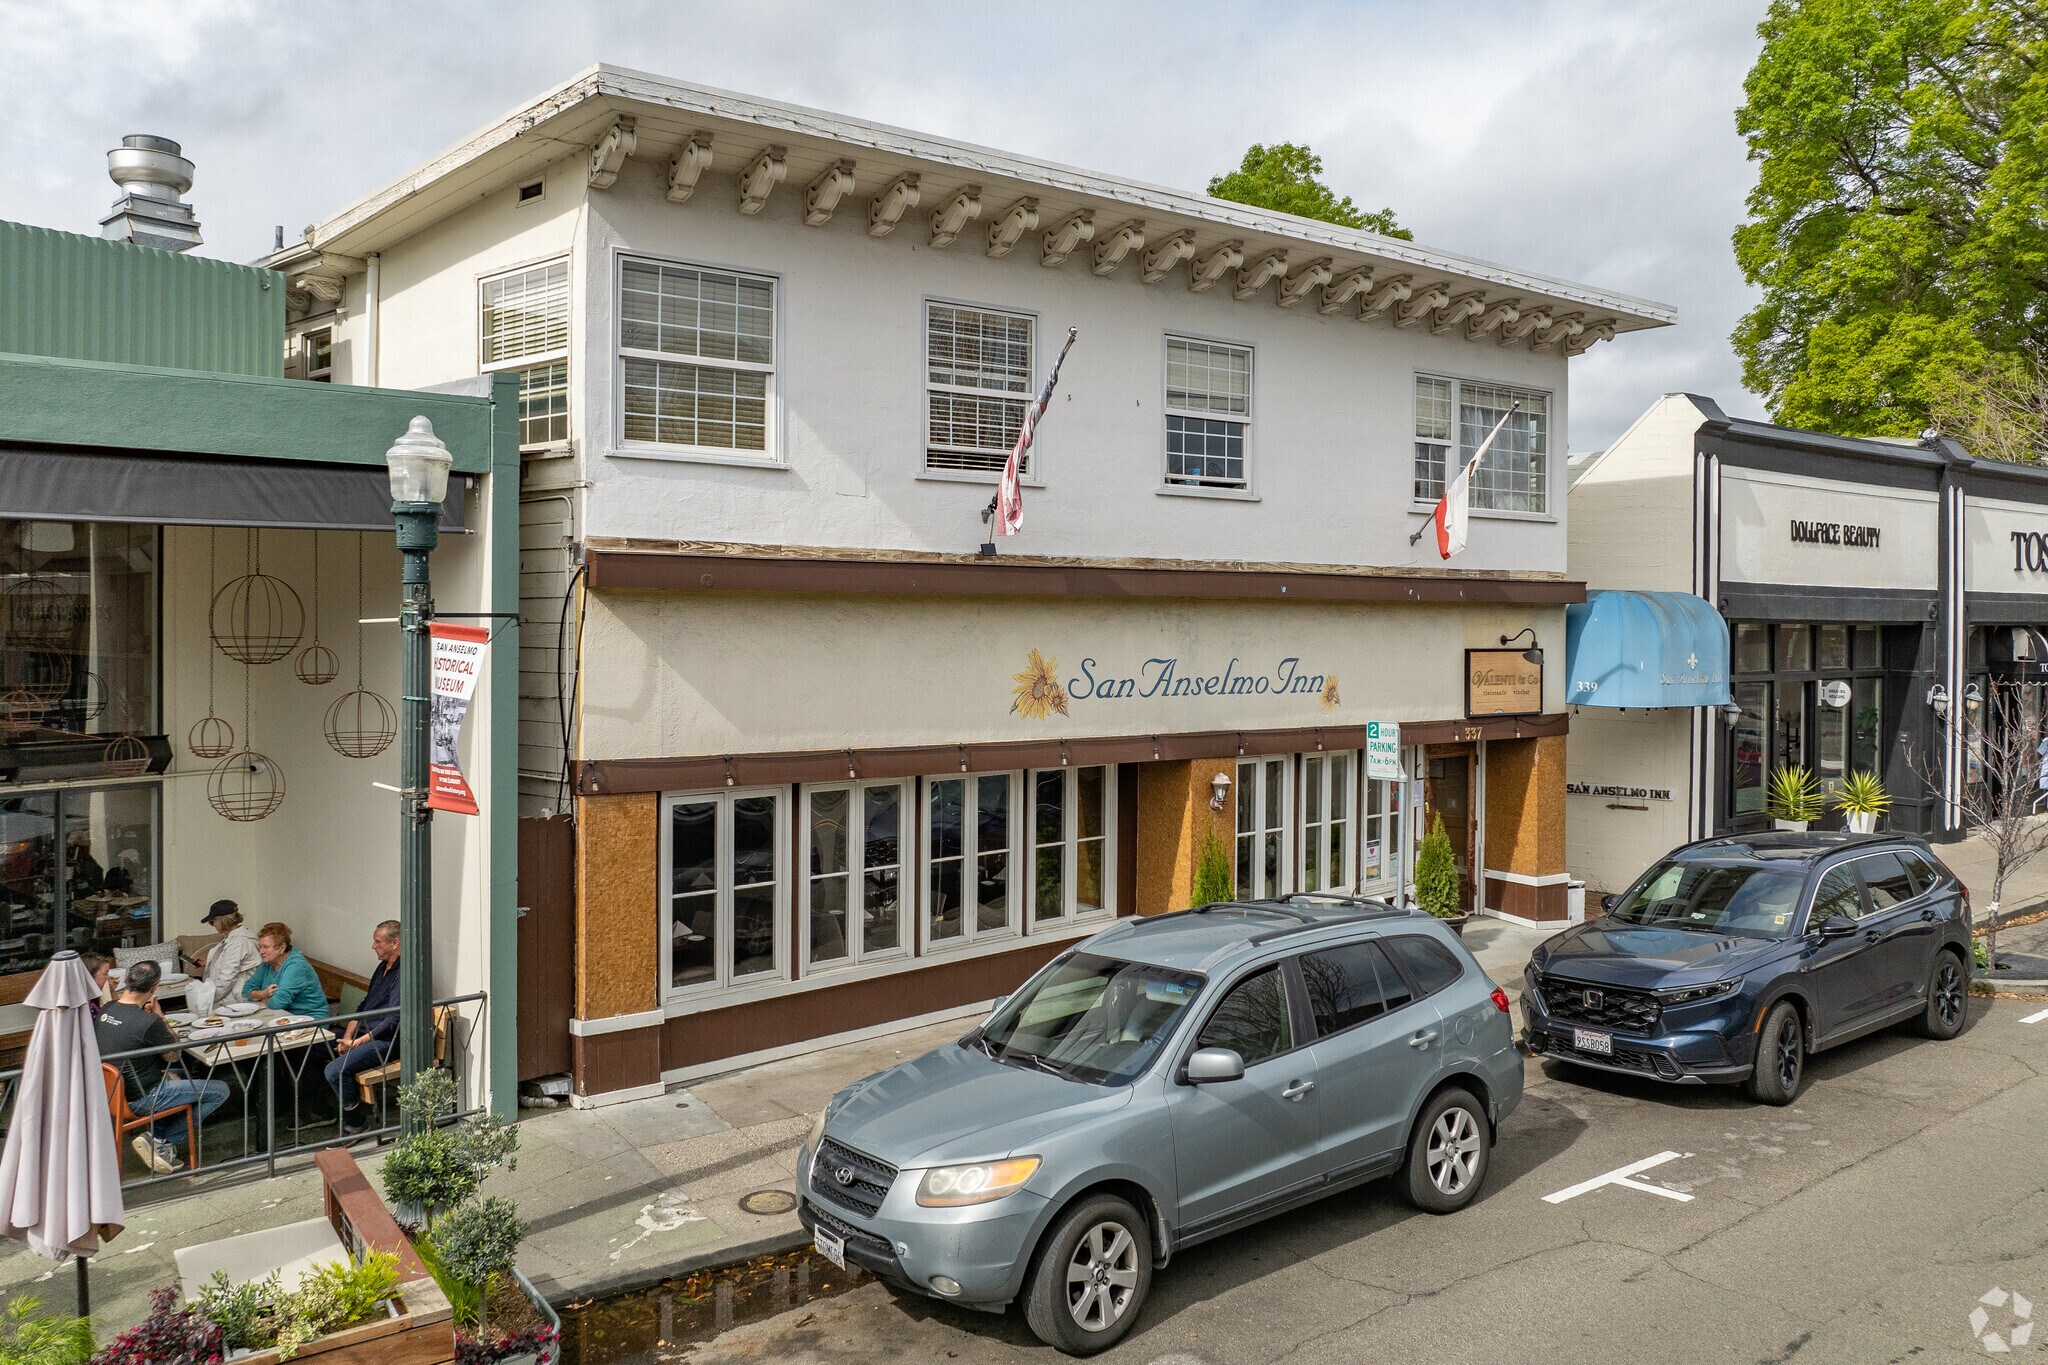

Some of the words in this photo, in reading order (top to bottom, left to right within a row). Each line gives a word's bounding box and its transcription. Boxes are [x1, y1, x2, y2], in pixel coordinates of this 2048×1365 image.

[1790, 519, 1840, 545] DOLLFACE
[1843, 524, 1880, 547] BEAUTY
[436, 642, 448, 652] SAN
[448, 644, 478, 656] ANSELMO
[1068, 657, 1135, 700] San
[1138, 657, 1269, 698] Anselmo
[1271, 657, 1324, 695] Inn
[1576, 681, 1598, 692] 339
[1369, 724, 1377, 736] 2
[1380, 728, 1396, 738] HOUR
[1464, 727, 1483, 740] 337
[1370, 741, 1397, 753] PARKING
[1566, 783, 1590, 795] SAN
[1592, 785, 1647, 798] ANSELMO
[1649, 789, 1671, 799] INN
[1576, 1036, 1610, 1051] 9SSB058
